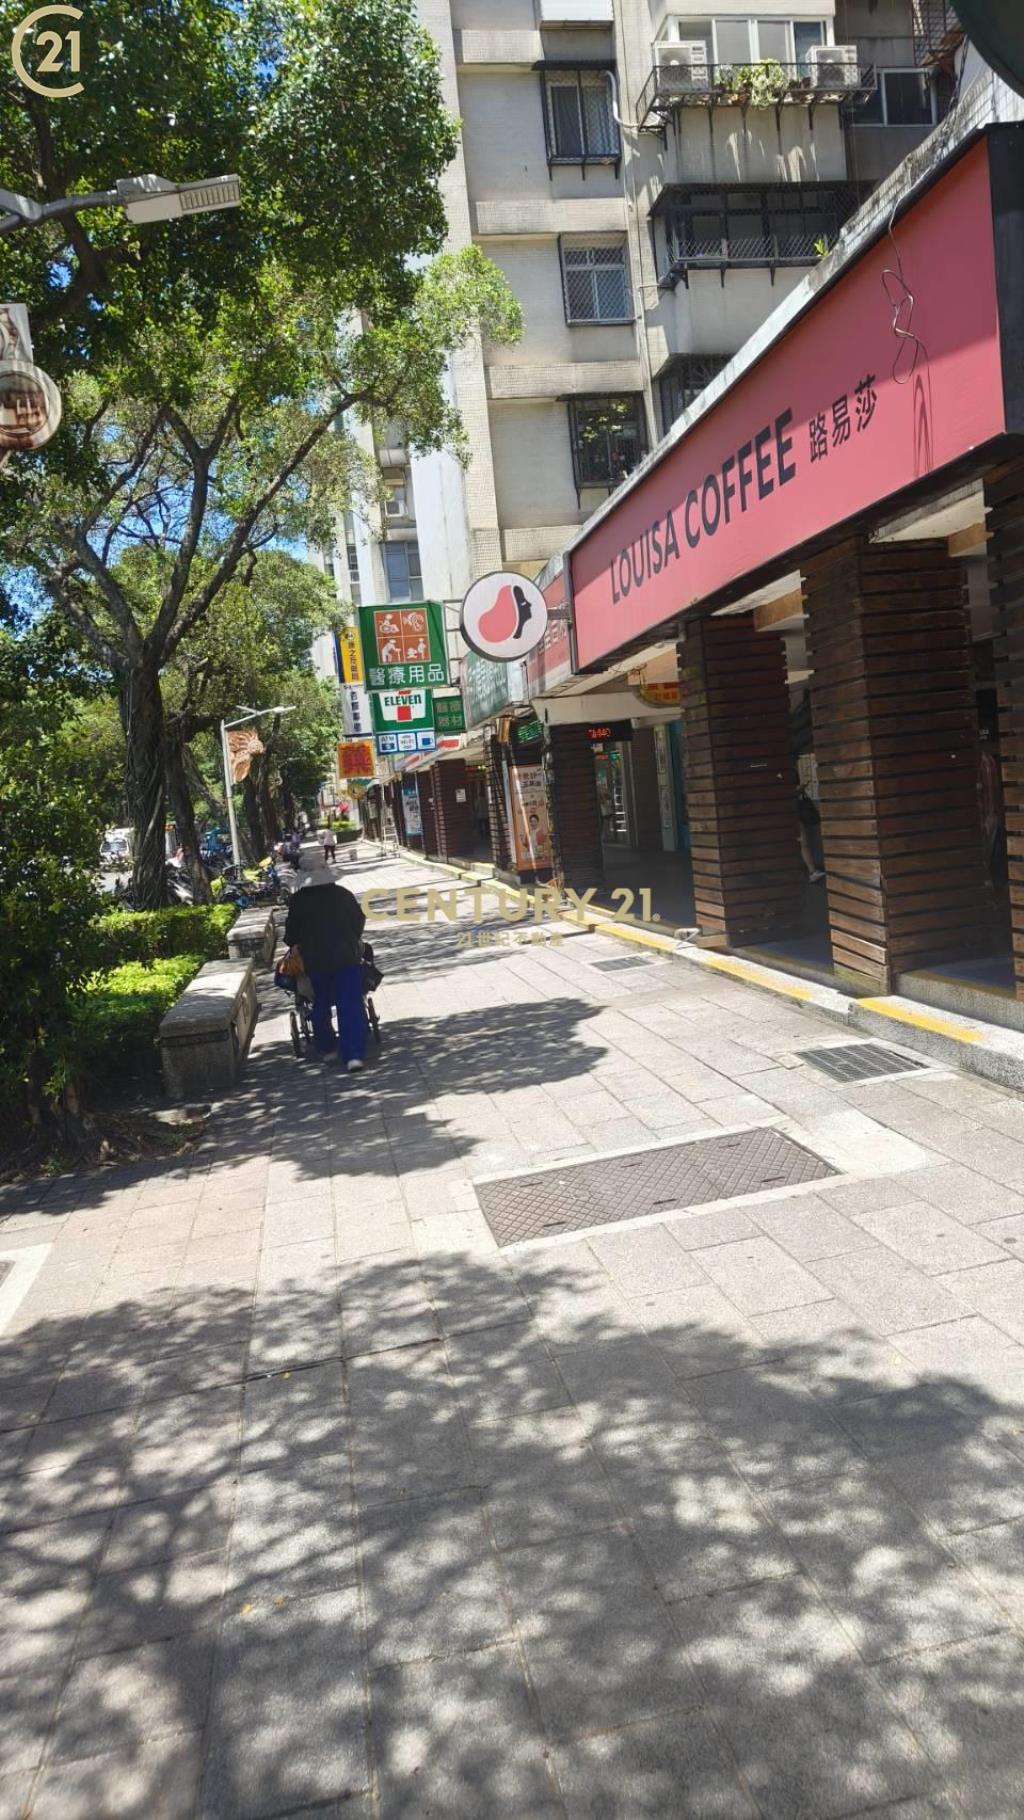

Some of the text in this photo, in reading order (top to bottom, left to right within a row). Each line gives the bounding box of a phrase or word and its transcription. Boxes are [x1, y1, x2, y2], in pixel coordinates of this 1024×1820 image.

[807, 373, 878, 463] 路易莎
[610, 408, 797, 605] LOUISA COFFEE
[368, 663, 445, 686] 醫療用品
